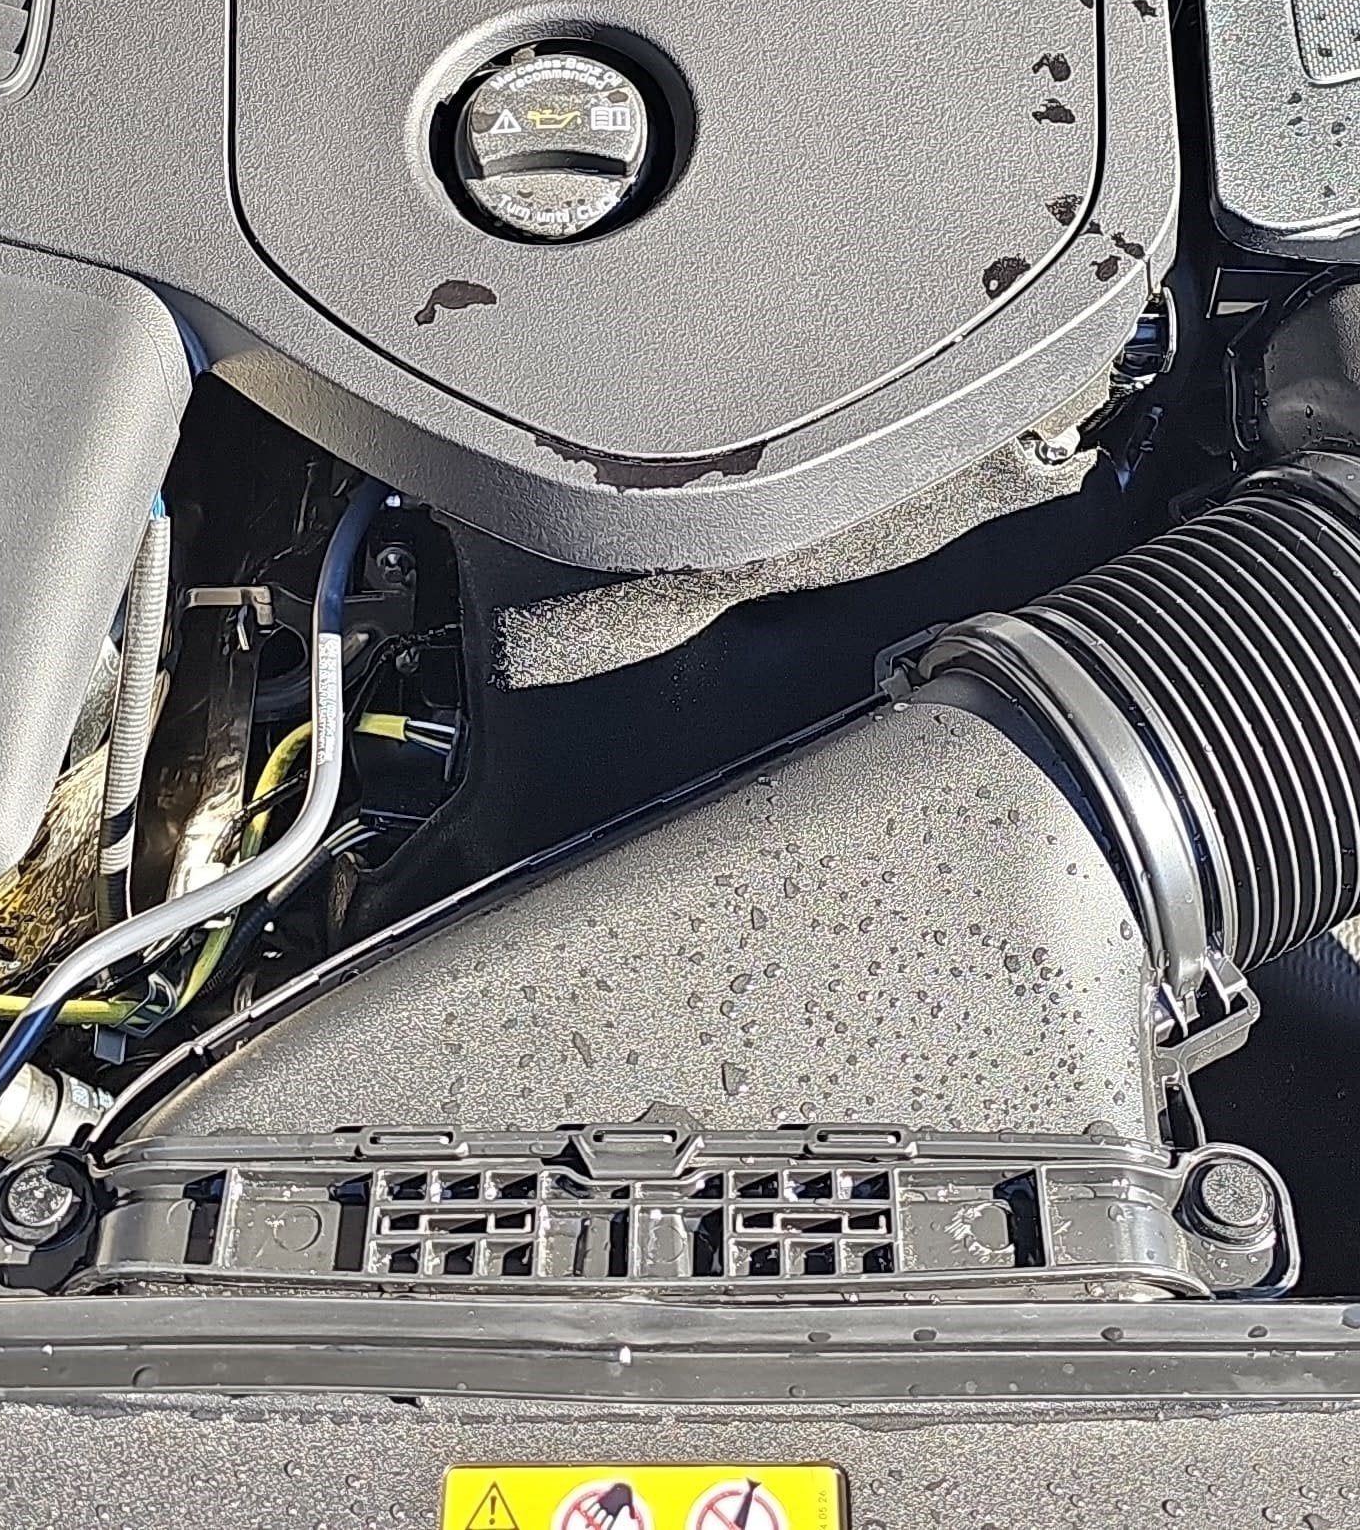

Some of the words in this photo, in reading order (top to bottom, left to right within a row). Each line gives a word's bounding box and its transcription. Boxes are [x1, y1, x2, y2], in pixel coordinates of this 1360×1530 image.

[490, 58, 602, 90] Mercedes-Benz
[603, 71, 622, 87] Oil
[509, 69, 609, 91] recommended
[500, 194, 530, 220] Turn
[537, 210, 570, 223] until
[817, 1489, 828, 1503] 26
